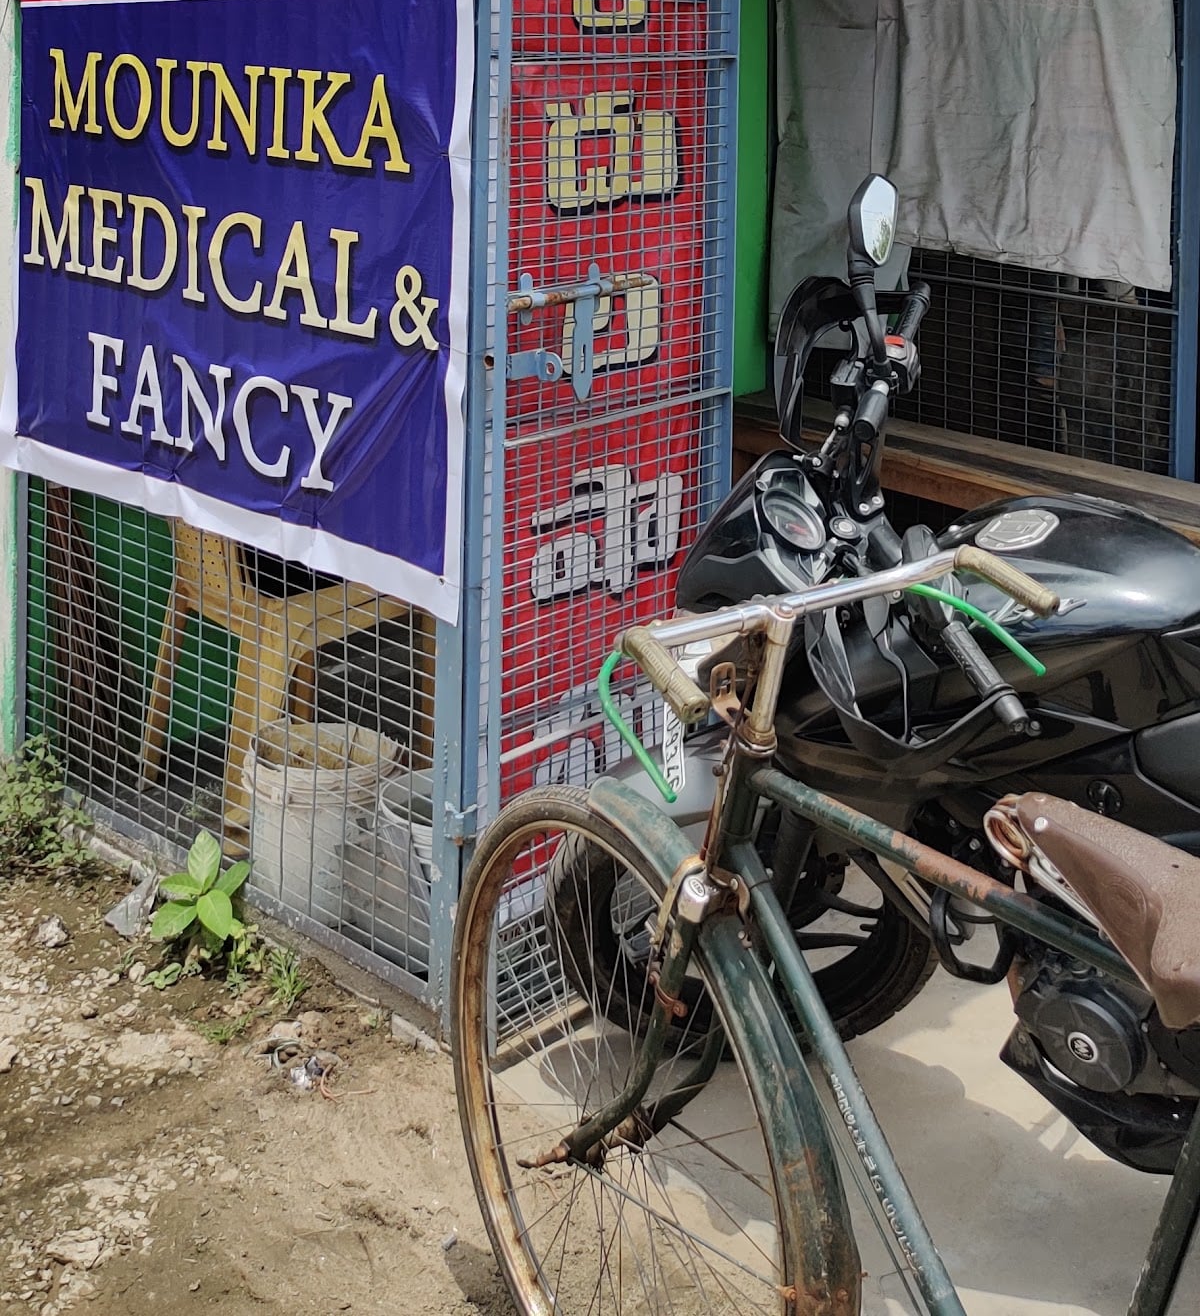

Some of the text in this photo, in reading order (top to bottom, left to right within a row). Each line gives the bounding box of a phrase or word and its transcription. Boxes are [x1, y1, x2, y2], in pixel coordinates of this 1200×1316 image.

[49, 48, 411, 174] MOUNIKA
[23, 178, 440, 351] MEDICAL &
[86, 331, 353, 492] FANCY
